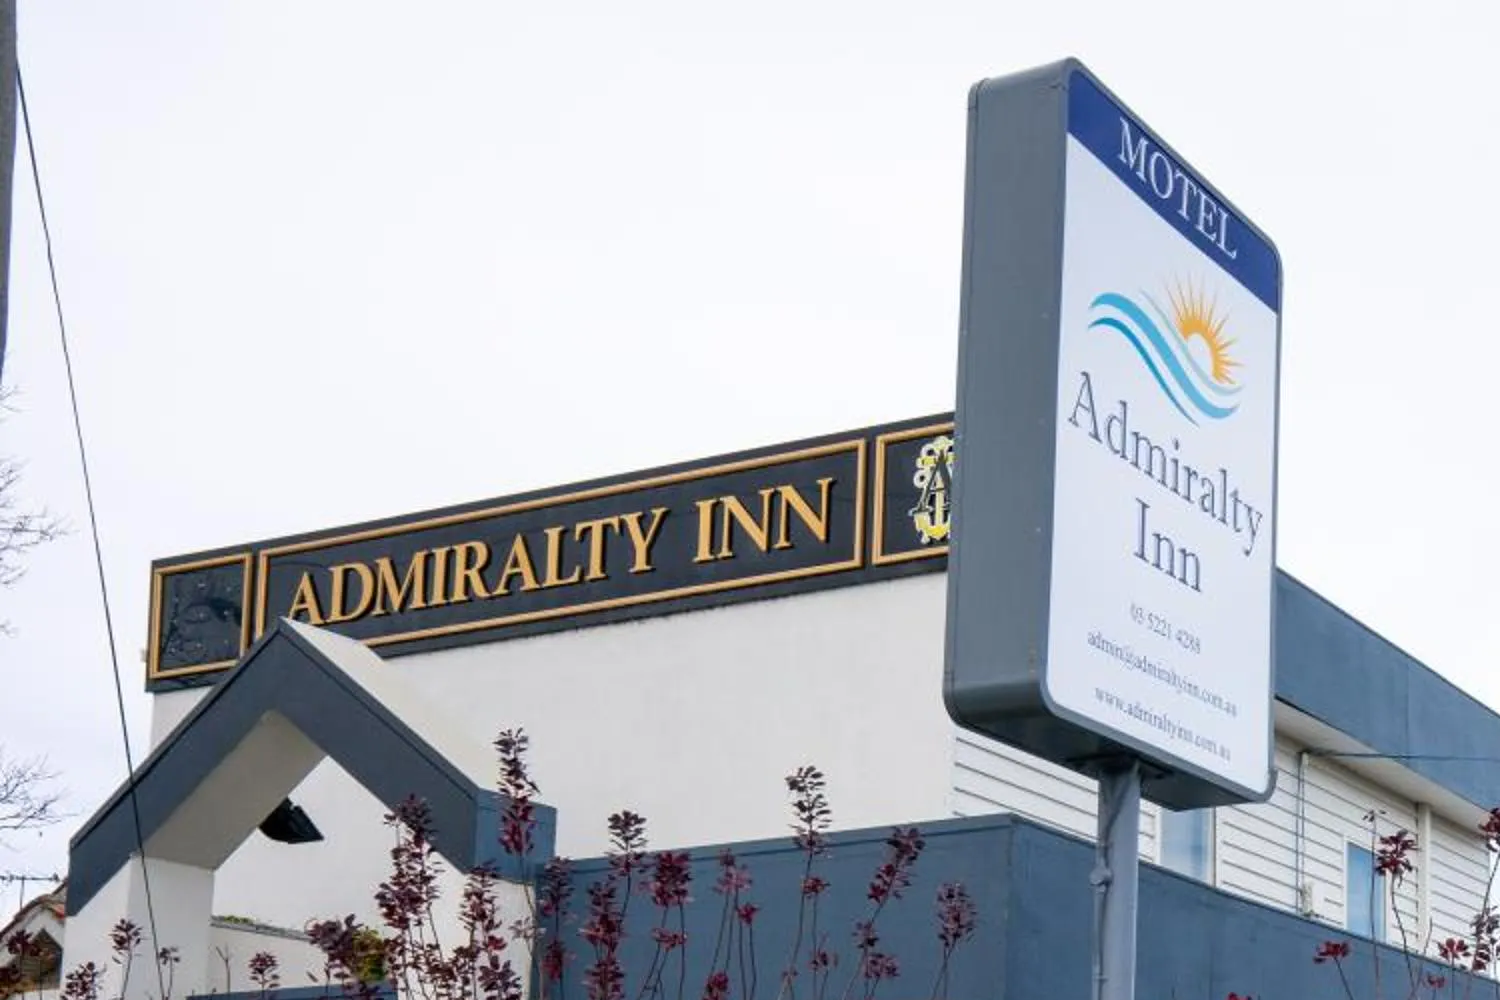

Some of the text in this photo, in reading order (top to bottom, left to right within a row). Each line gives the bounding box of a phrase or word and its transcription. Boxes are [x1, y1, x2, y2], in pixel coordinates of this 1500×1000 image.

[1118, 117, 1238, 260] MOTEL
[1067, 371, 1263, 557] Admiralty
[288, 477, 835, 626] ADMIRALTY INN
[1133, 497, 1203, 593] Inn
[1130, 602, 1146, 625] 03
[1147, 612, 1172, 640] 5221
[1094, 686, 1232, 762] www.admiraltyinn.com.au
